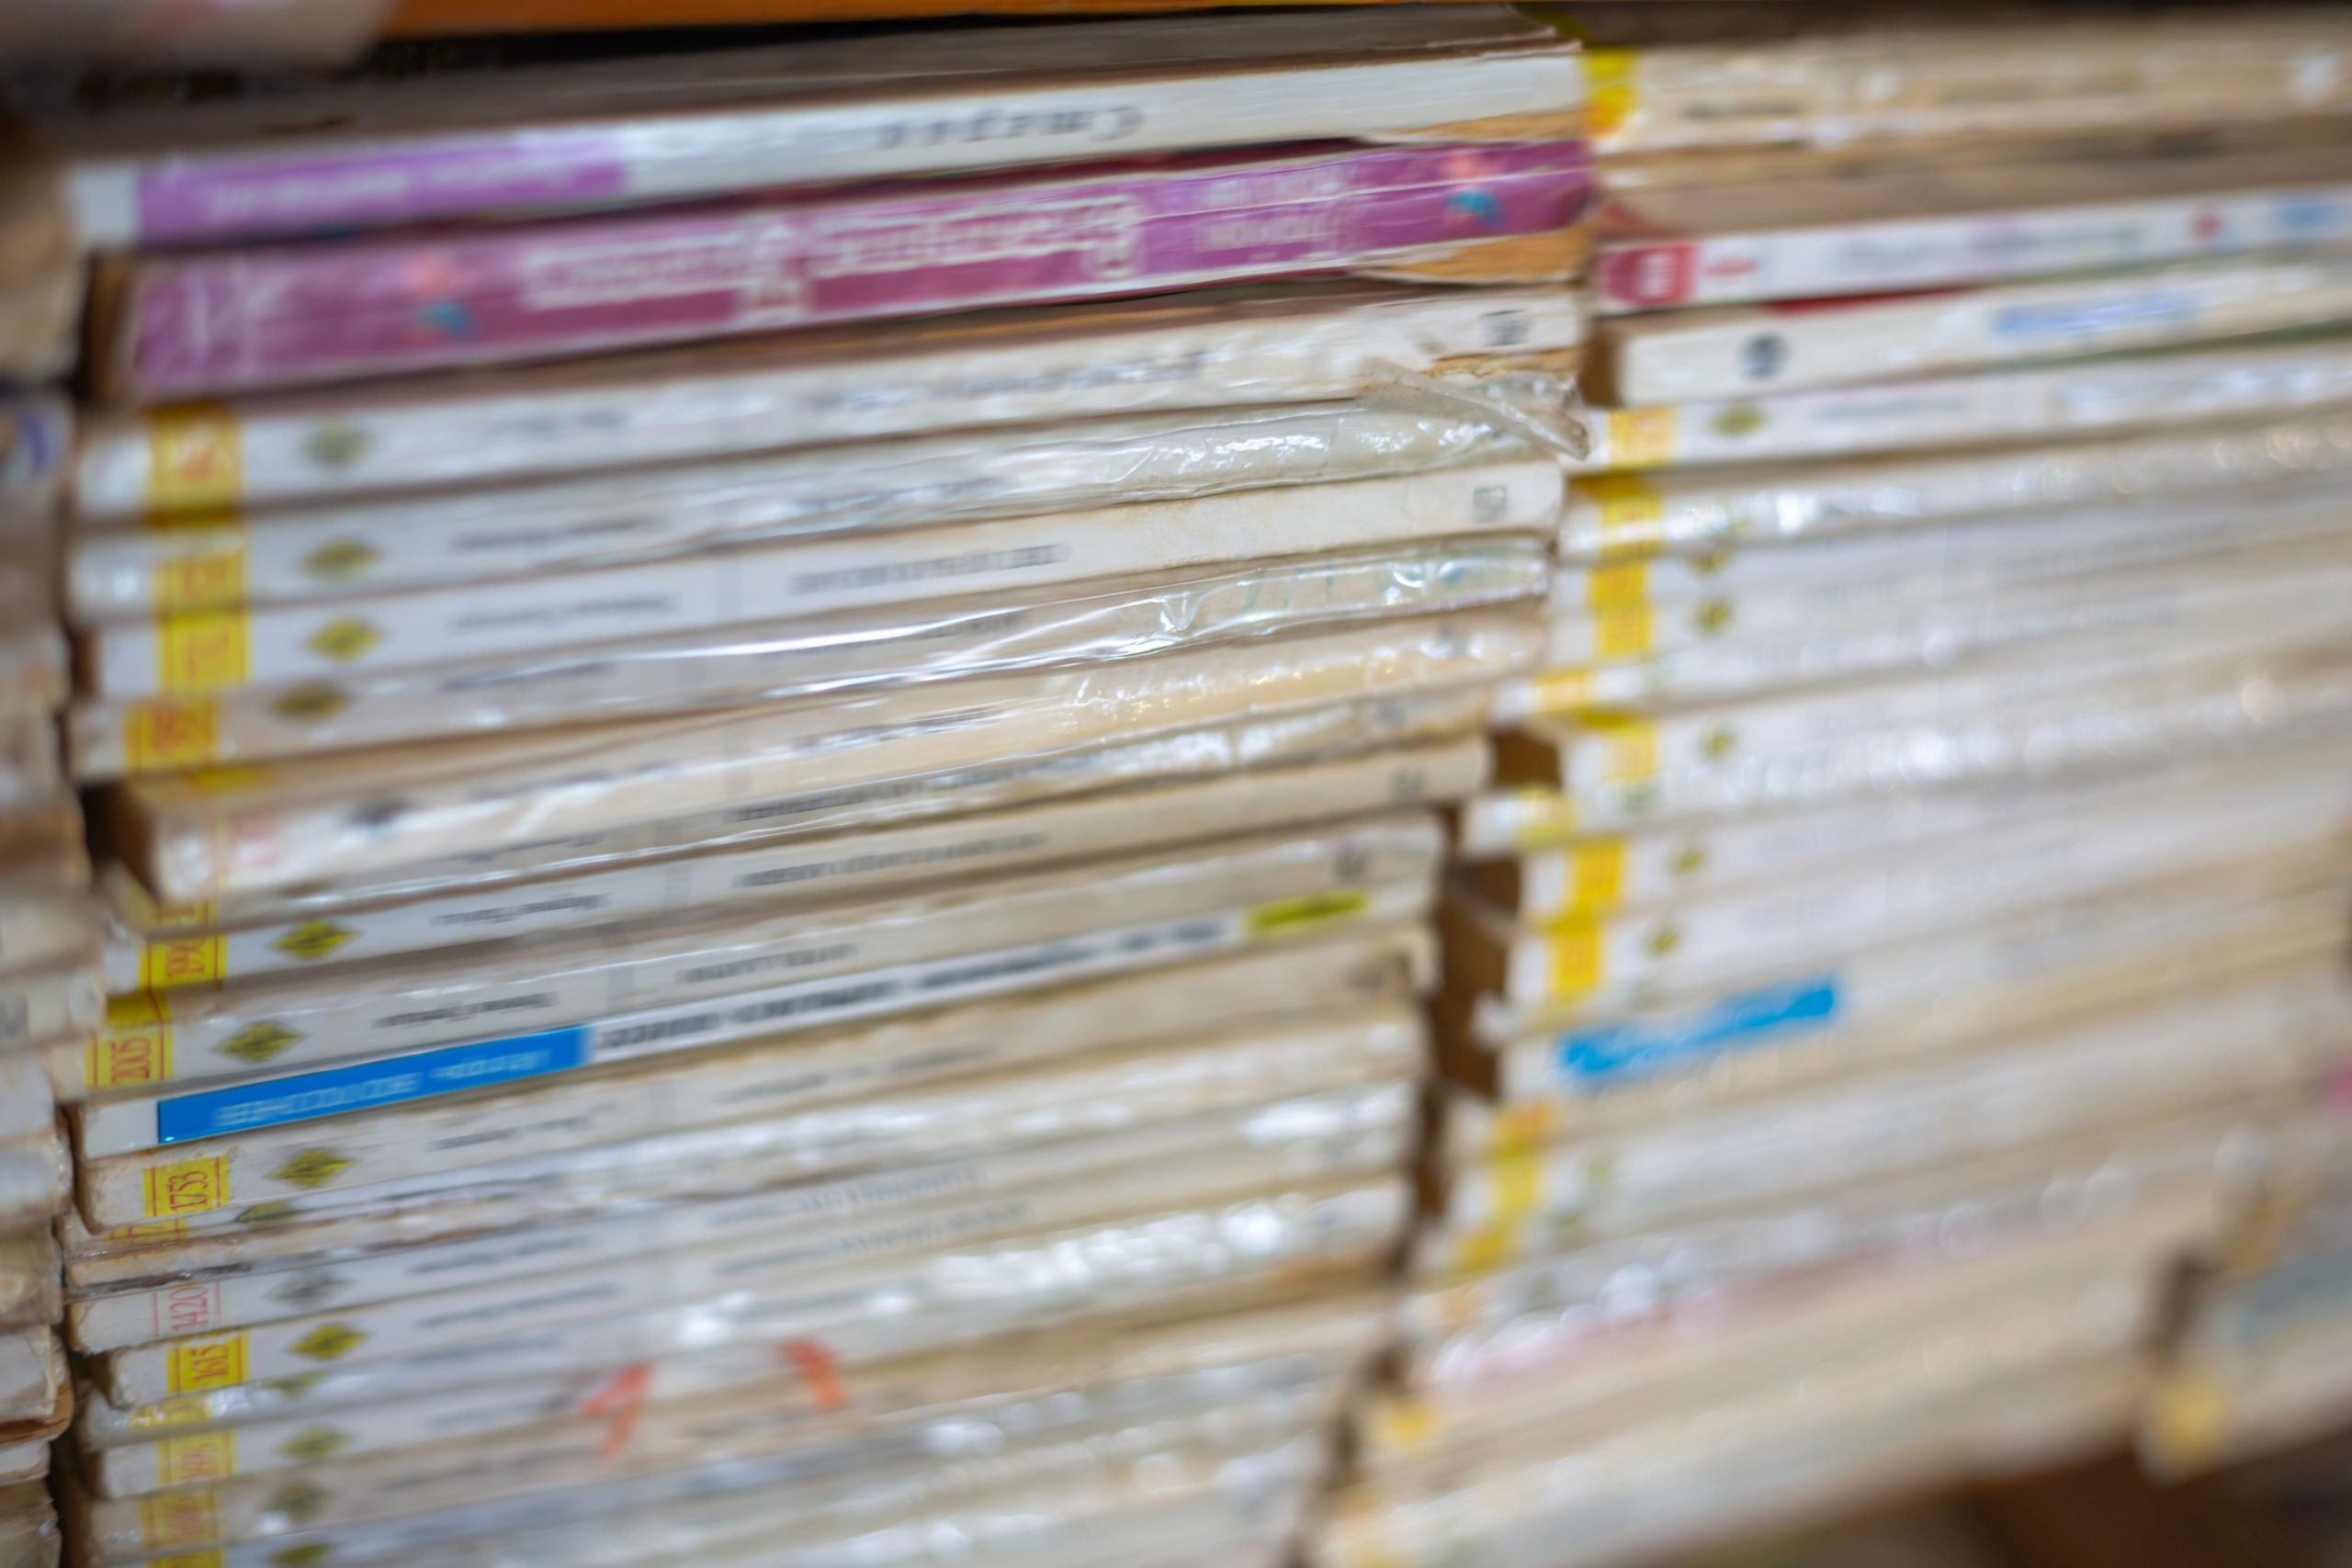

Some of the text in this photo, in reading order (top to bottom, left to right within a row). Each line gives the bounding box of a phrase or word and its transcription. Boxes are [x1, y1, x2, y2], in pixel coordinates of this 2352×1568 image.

[167, 1161, 208, 1211] 1753
[169, 1285, 209, 1331] 1420
[190, 1344, 229, 1382] 1615
